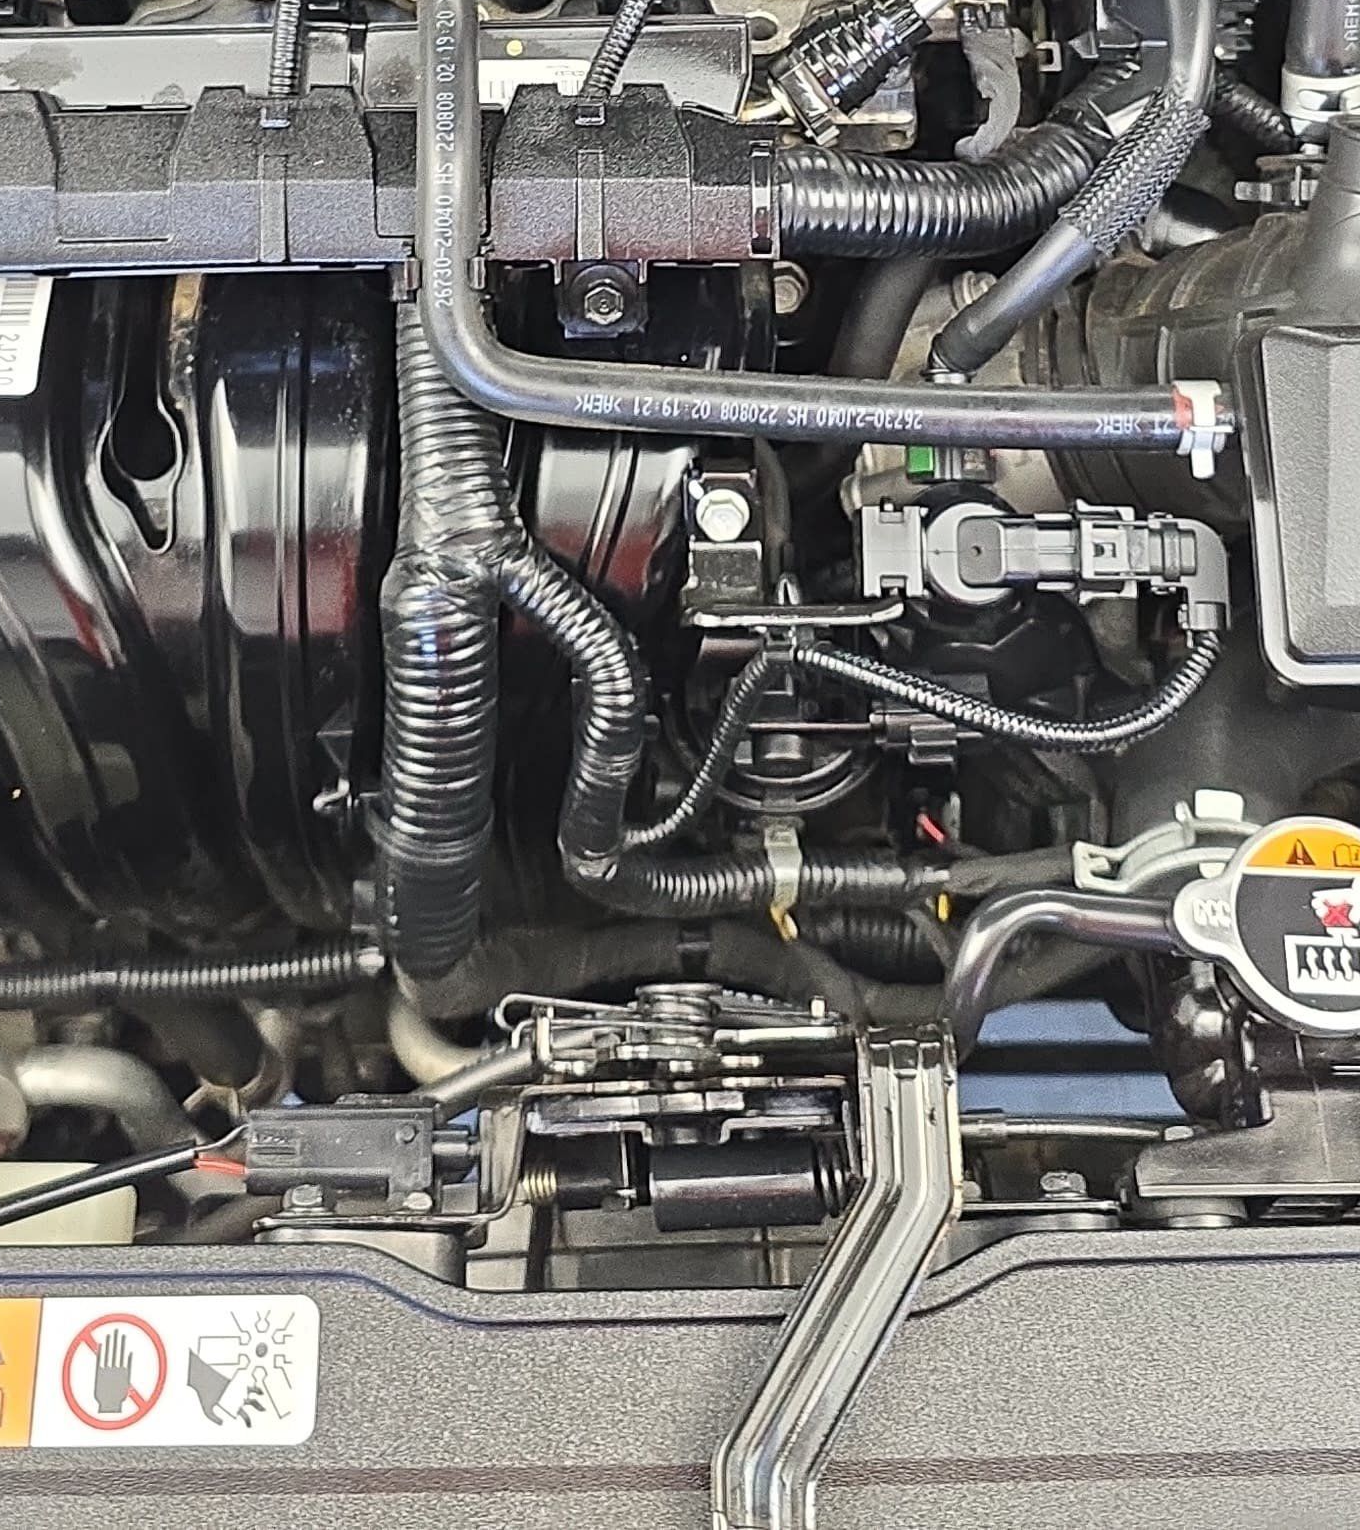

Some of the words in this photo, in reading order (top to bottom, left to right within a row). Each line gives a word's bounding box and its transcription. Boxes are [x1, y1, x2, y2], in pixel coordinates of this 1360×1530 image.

[437, 161, 455, 185] HS
[720, 400, 778, 423] 220808
[787, 404, 809, 427] HS
